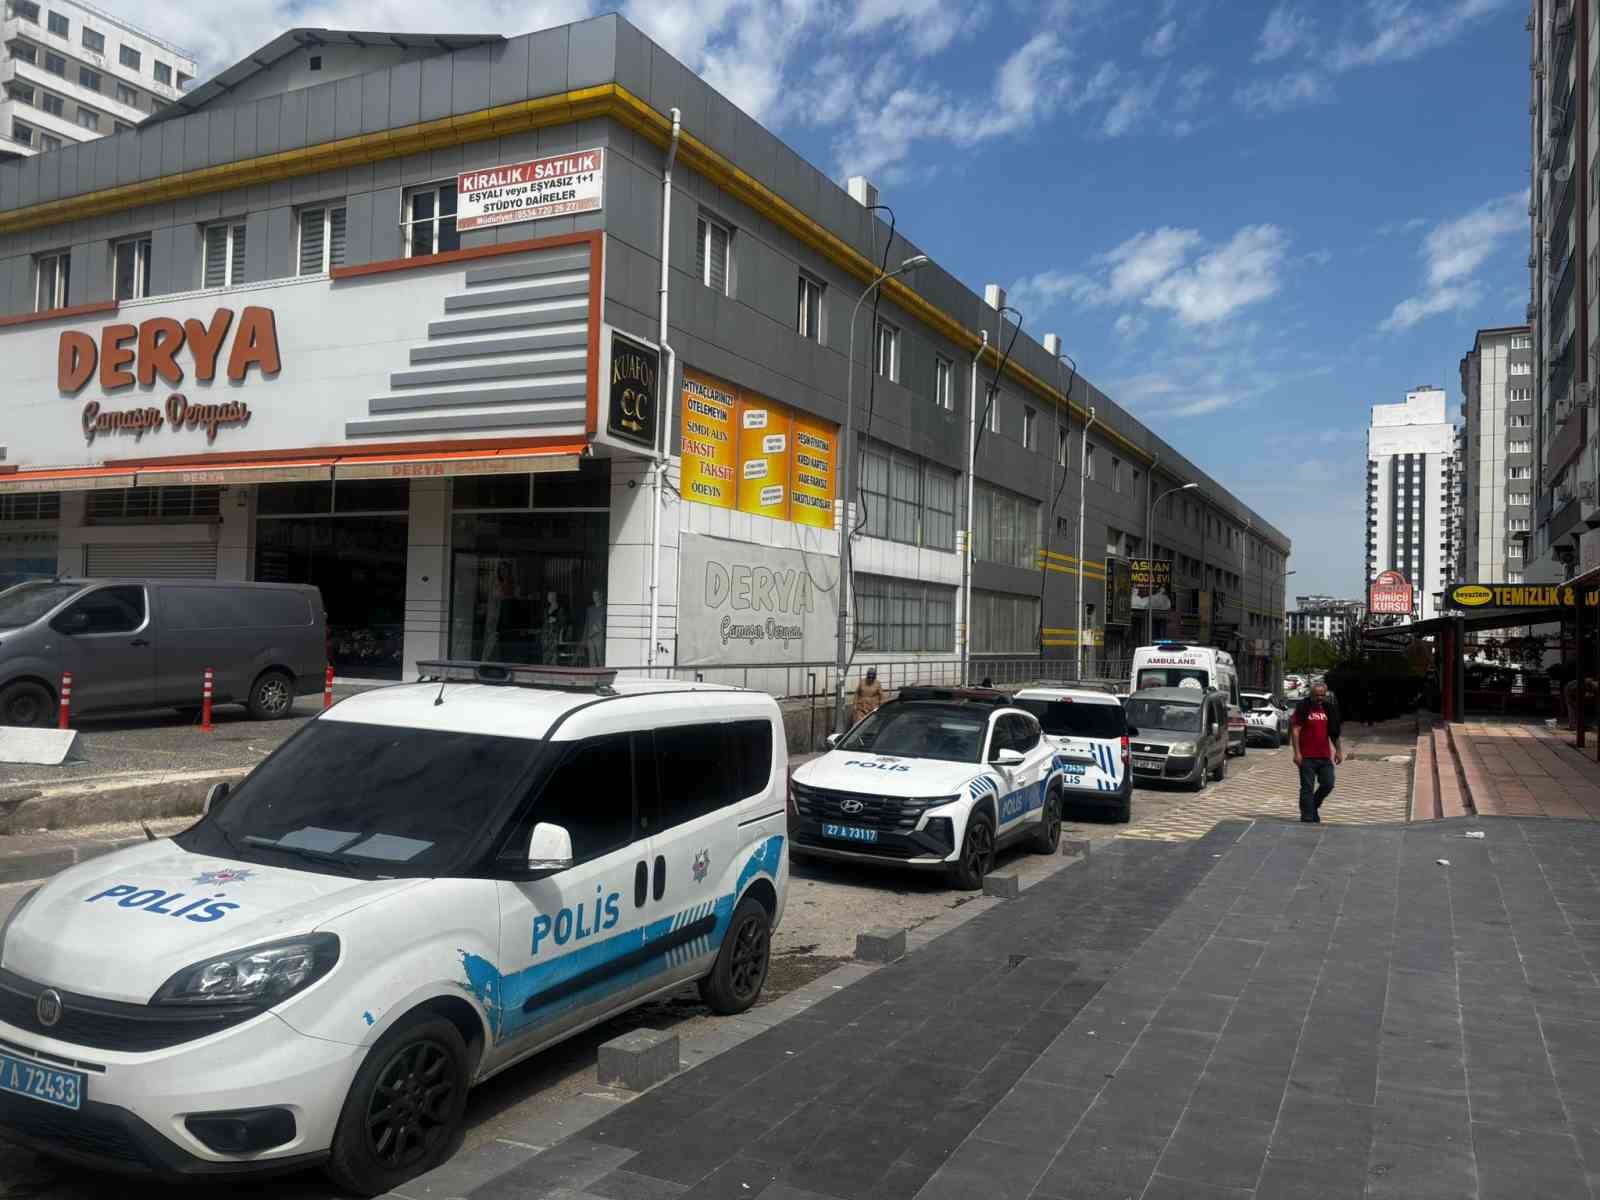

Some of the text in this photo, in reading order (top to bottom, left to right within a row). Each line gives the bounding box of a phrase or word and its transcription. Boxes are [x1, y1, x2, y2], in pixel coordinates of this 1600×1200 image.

[463, 154, 594, 192] KİRALIK / SATILIK
[505, 186, 527, 196] veya
[530, 176, 573, 192] EŞYASIZ
[576, 173, 594, 184] 1+1
[483, 189, 576, 213] STÜDYO DAİRELER
[57, 306, 281, 394] DERYA
[391, 463, 444, 476] DERYA
[704, 560, 815, 615] DERYA
[1494, 586, 1560, 605] TEMİZLİK
[1147, 657, 1196, 665] AMBULANS
[844, 759, 911, 772] POLİS
[85, 884, 241, 923] POLİS
[530, 886, 620, 955] POLİS
[10, 1063, 19, 1089] A
[25, 1067, 76, 1103] 72433
